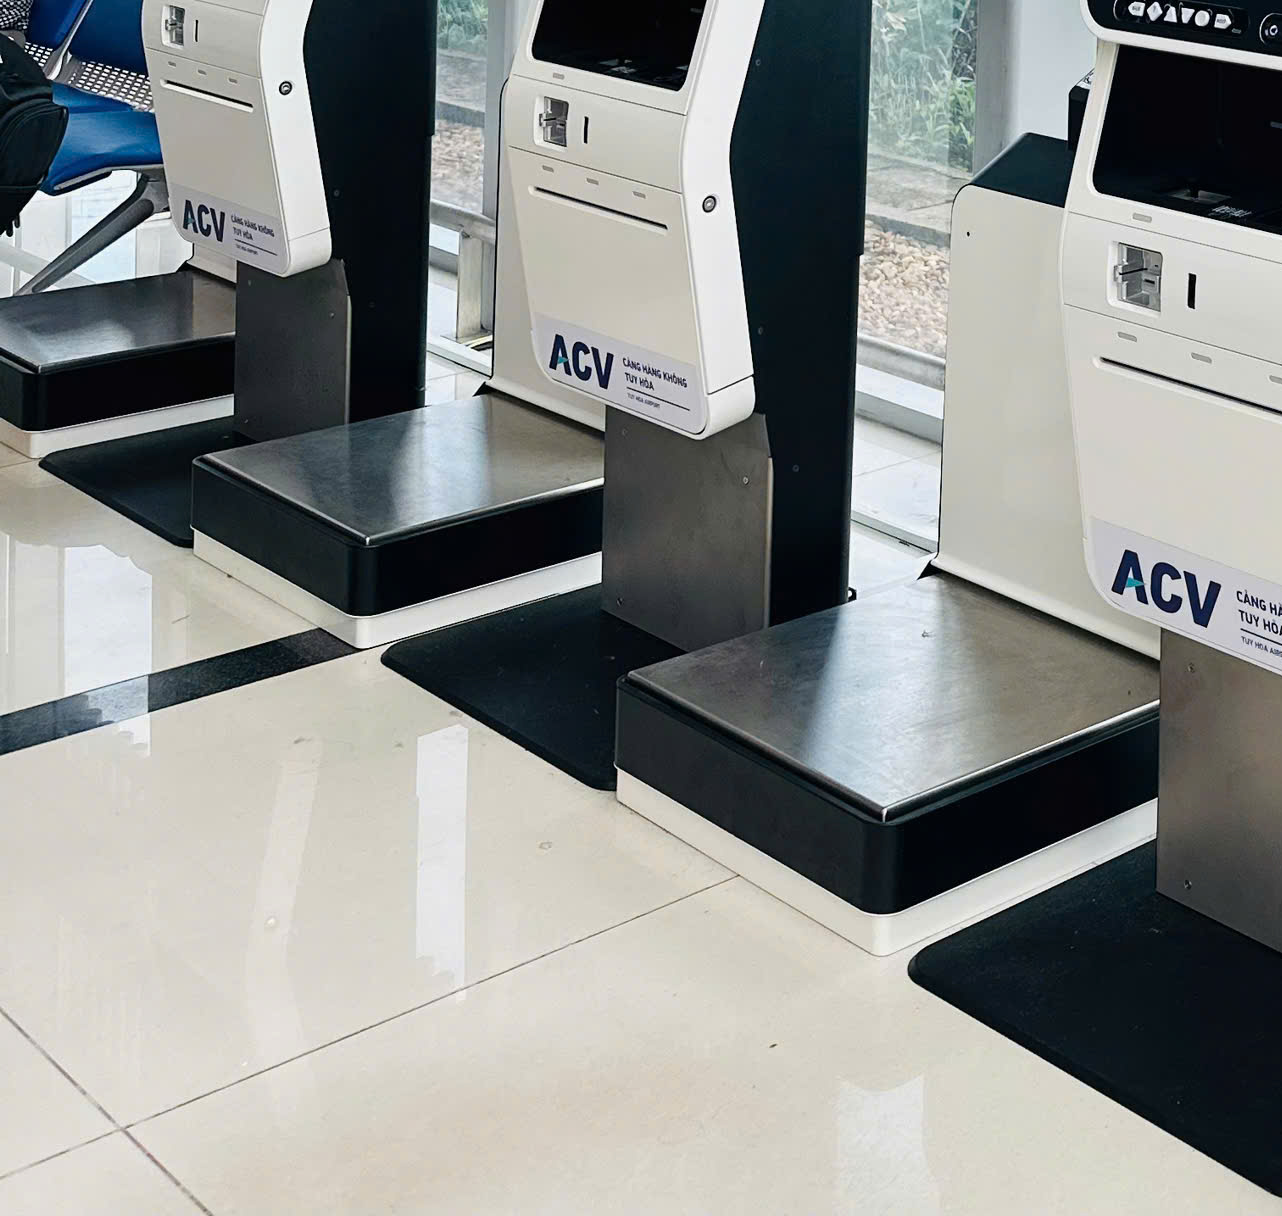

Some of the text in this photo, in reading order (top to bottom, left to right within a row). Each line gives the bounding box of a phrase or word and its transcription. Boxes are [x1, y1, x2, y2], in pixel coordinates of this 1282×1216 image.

[182, 199, 226, 242] ACV
[548, 333, 615, 390] ACV
[624, 372, 638, 385] TUY
[1111, 548, 1222, 629] ACV
[1236, 589, 1267, 611] CẢNG
[1237, 609, 1260, 627] TUY
[1241, 636, 1254, 646] TUY
[1255, 641, 1269, 653] HOA
